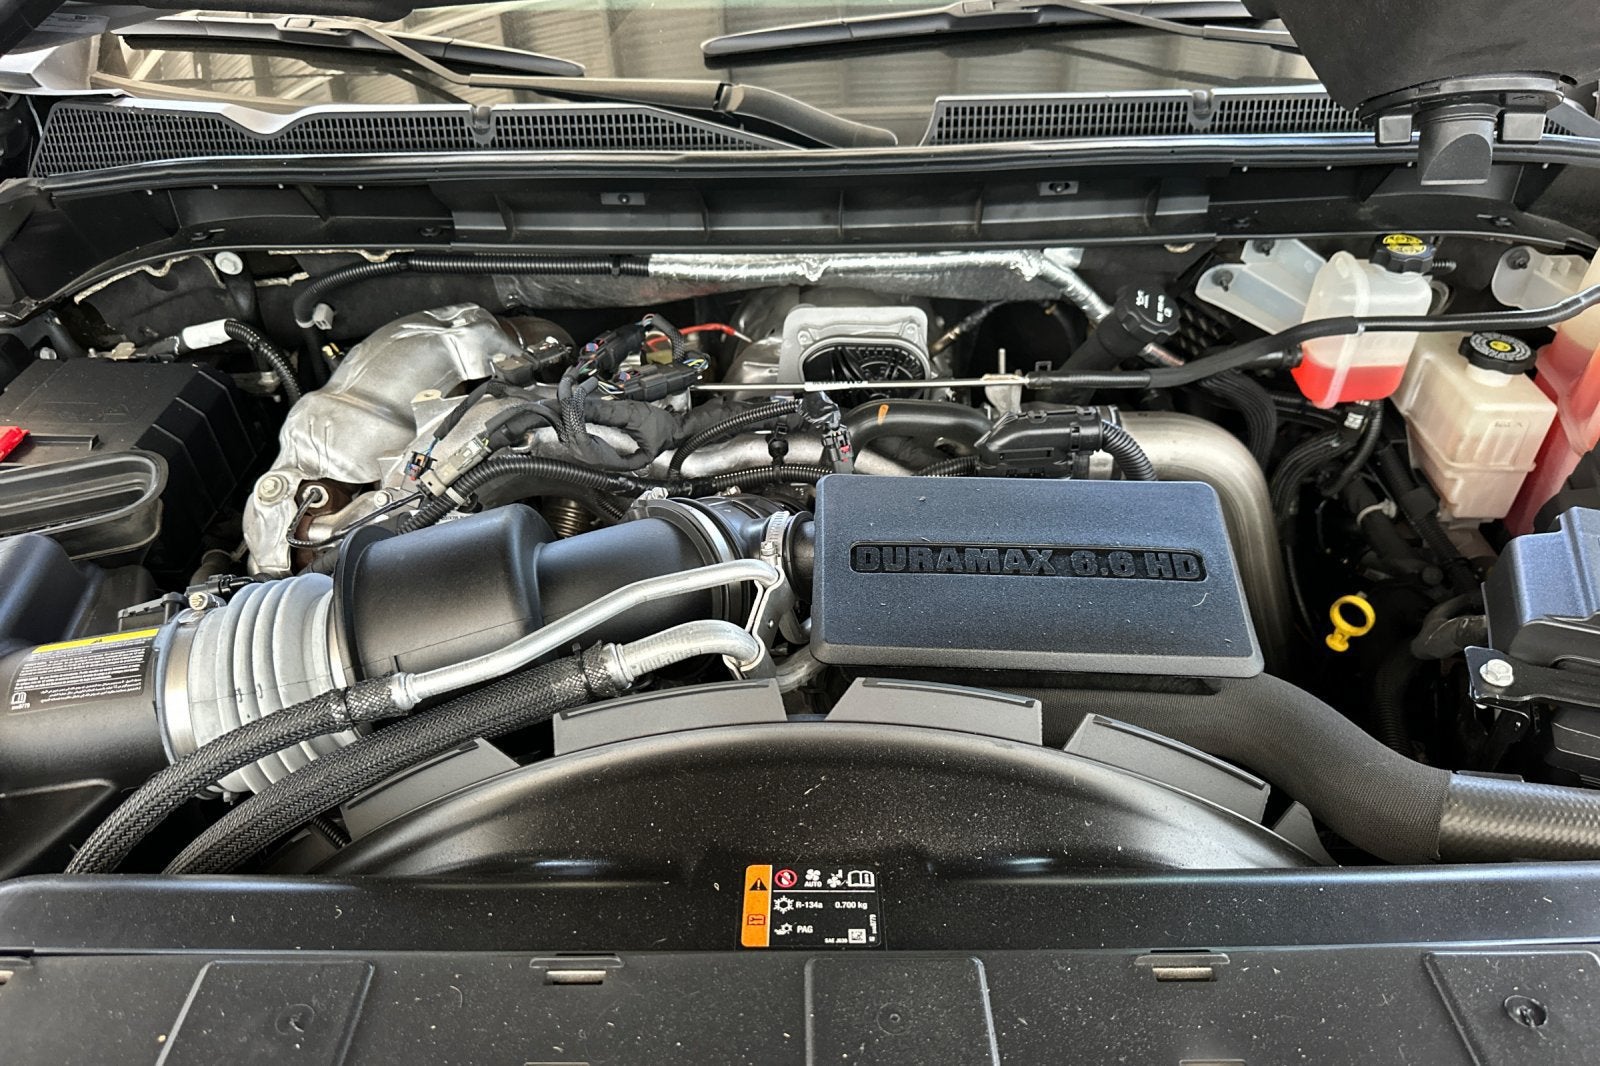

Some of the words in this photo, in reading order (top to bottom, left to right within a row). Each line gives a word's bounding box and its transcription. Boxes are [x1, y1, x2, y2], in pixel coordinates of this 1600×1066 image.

[855, 546, 1056, 576] DURAMAX
[1070, 550, 1136, 578] 6.6
[1144, 551, 1201, 580] HD
[804, 880, 823, 888] AUTO
[795, 901, 824, 909] R-134a
[834, 901, 857, 909] 0.700
[857, 901, 868, 910] kg
[796, 925, 814, 934] PAG
